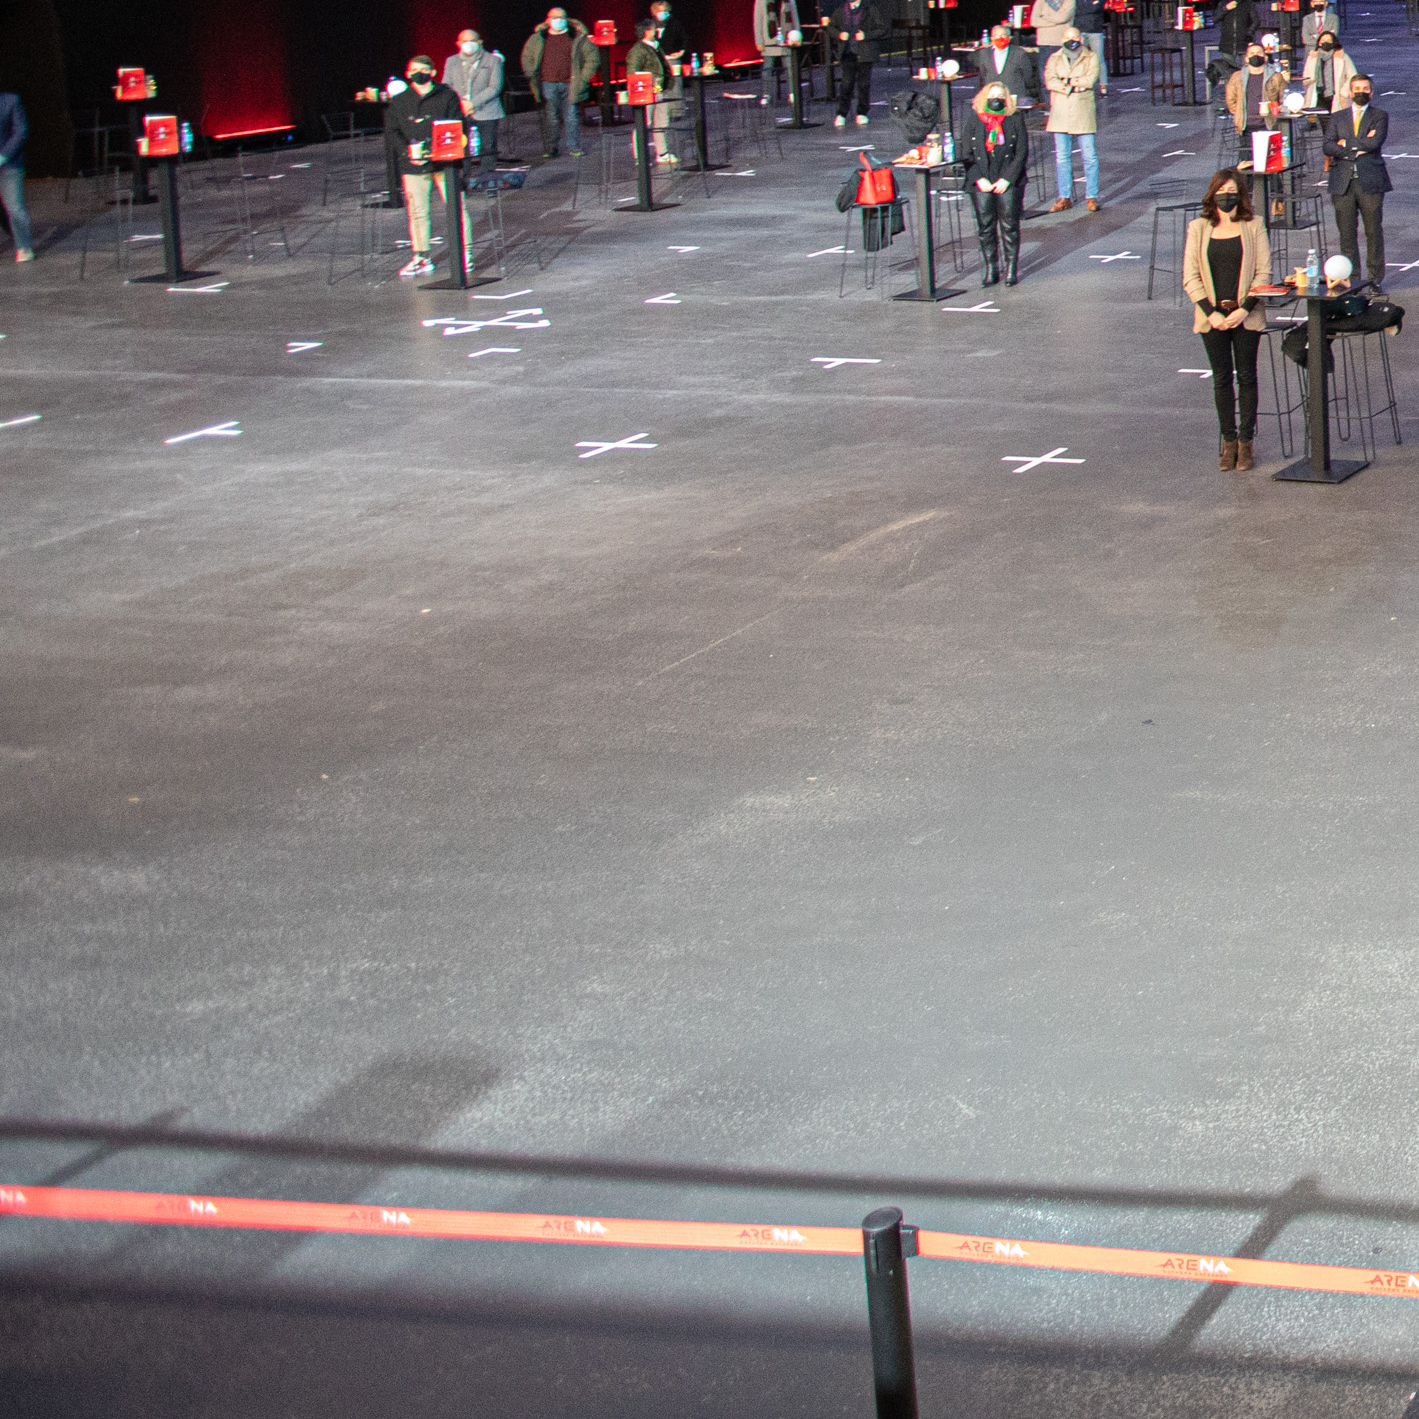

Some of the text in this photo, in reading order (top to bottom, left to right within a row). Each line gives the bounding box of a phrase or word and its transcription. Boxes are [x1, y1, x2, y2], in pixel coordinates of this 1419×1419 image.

[349, 1208, 411, 1225] ARENA
[538, 1218, 609, 1234] ARENA
[737, 1228, 807, 1242] ARENA
[954, 1240, 1030, 1258] ARENA
[1154, 1258, 1234, 1273] ARENA
